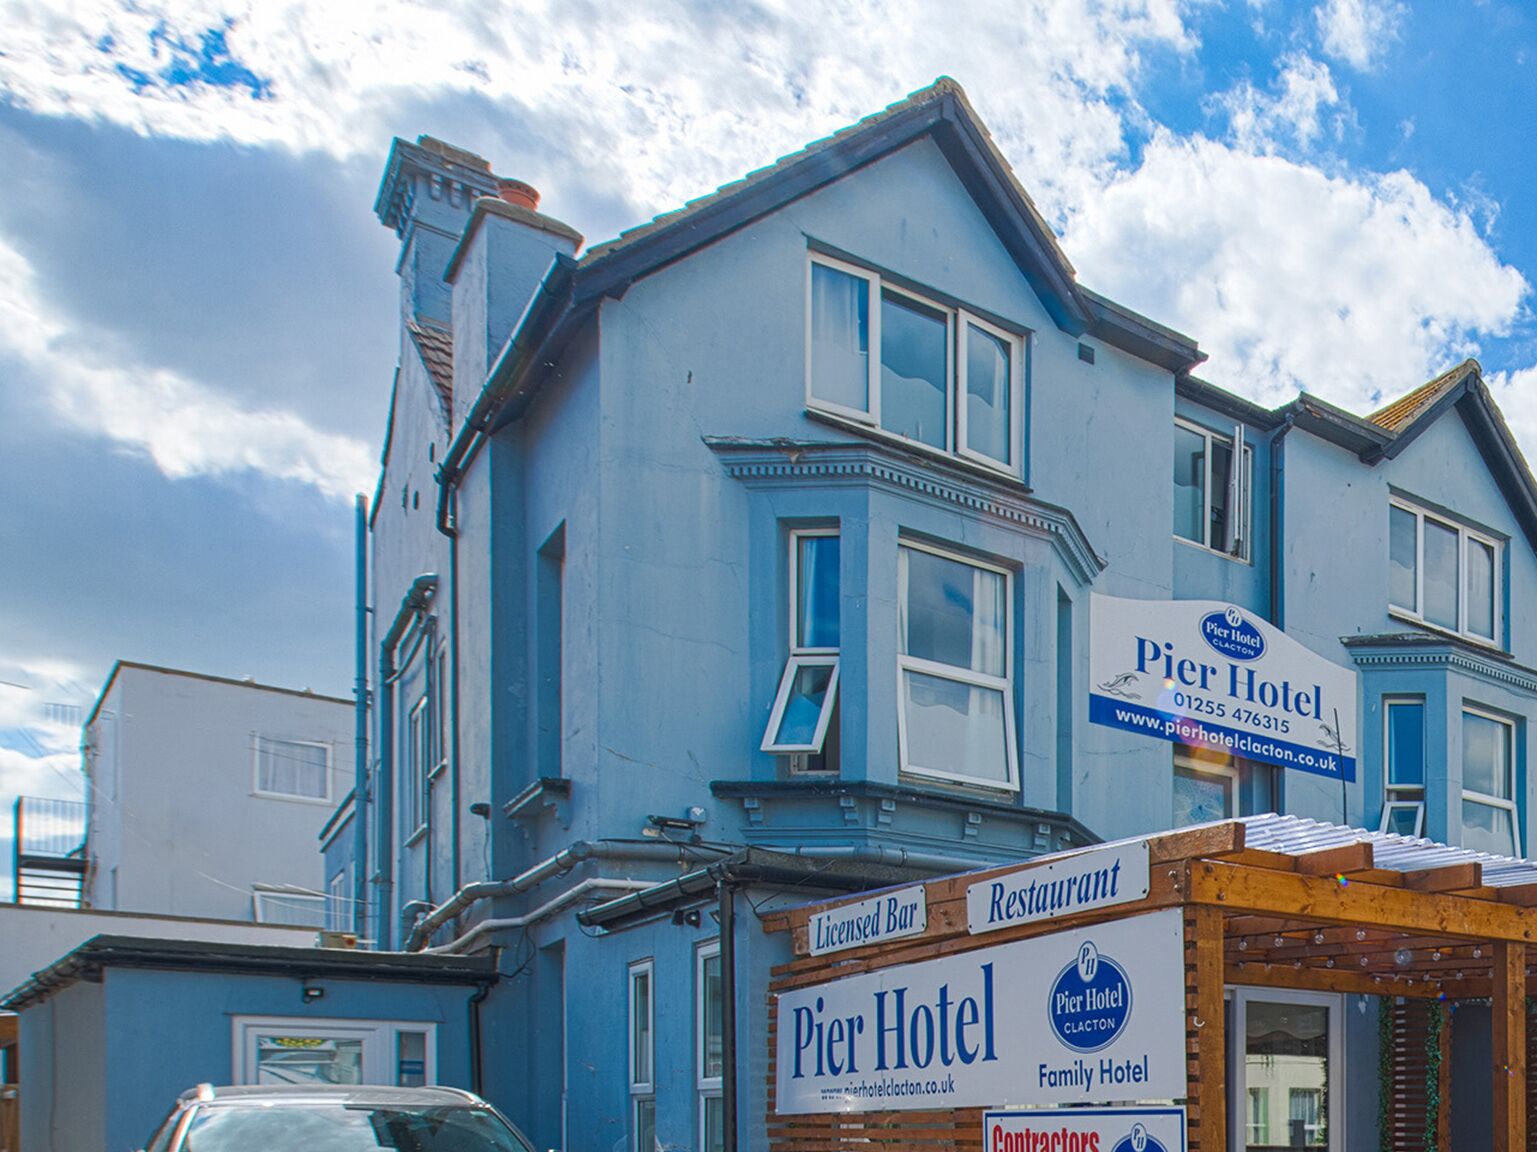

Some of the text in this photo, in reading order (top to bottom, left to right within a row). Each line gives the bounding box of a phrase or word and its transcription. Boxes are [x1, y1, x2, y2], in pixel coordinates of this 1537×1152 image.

[1206, 621, 1260, 648] Pier Hotel
[1212, 638, 1255, 656] CLACTON
[1135, 636, 1323, 721] Pier Hotel
[1174, 692, 1290, 734] 01255 476315
[1116, 709, 1338, 772] www.pierhotelclacton.co.uk
[988, 858, 1121, 924] Restaurant
[816, 898, 918, 951] Licensed Bar
[1056, 982, 1123, 1015] Pier Hotel
[792, 962, 998, 1079] Pier Hotel
[1063, 1018, 1115, 1034] CLACTON
[1039, 1054, 1148, 1092] Family Hotel
